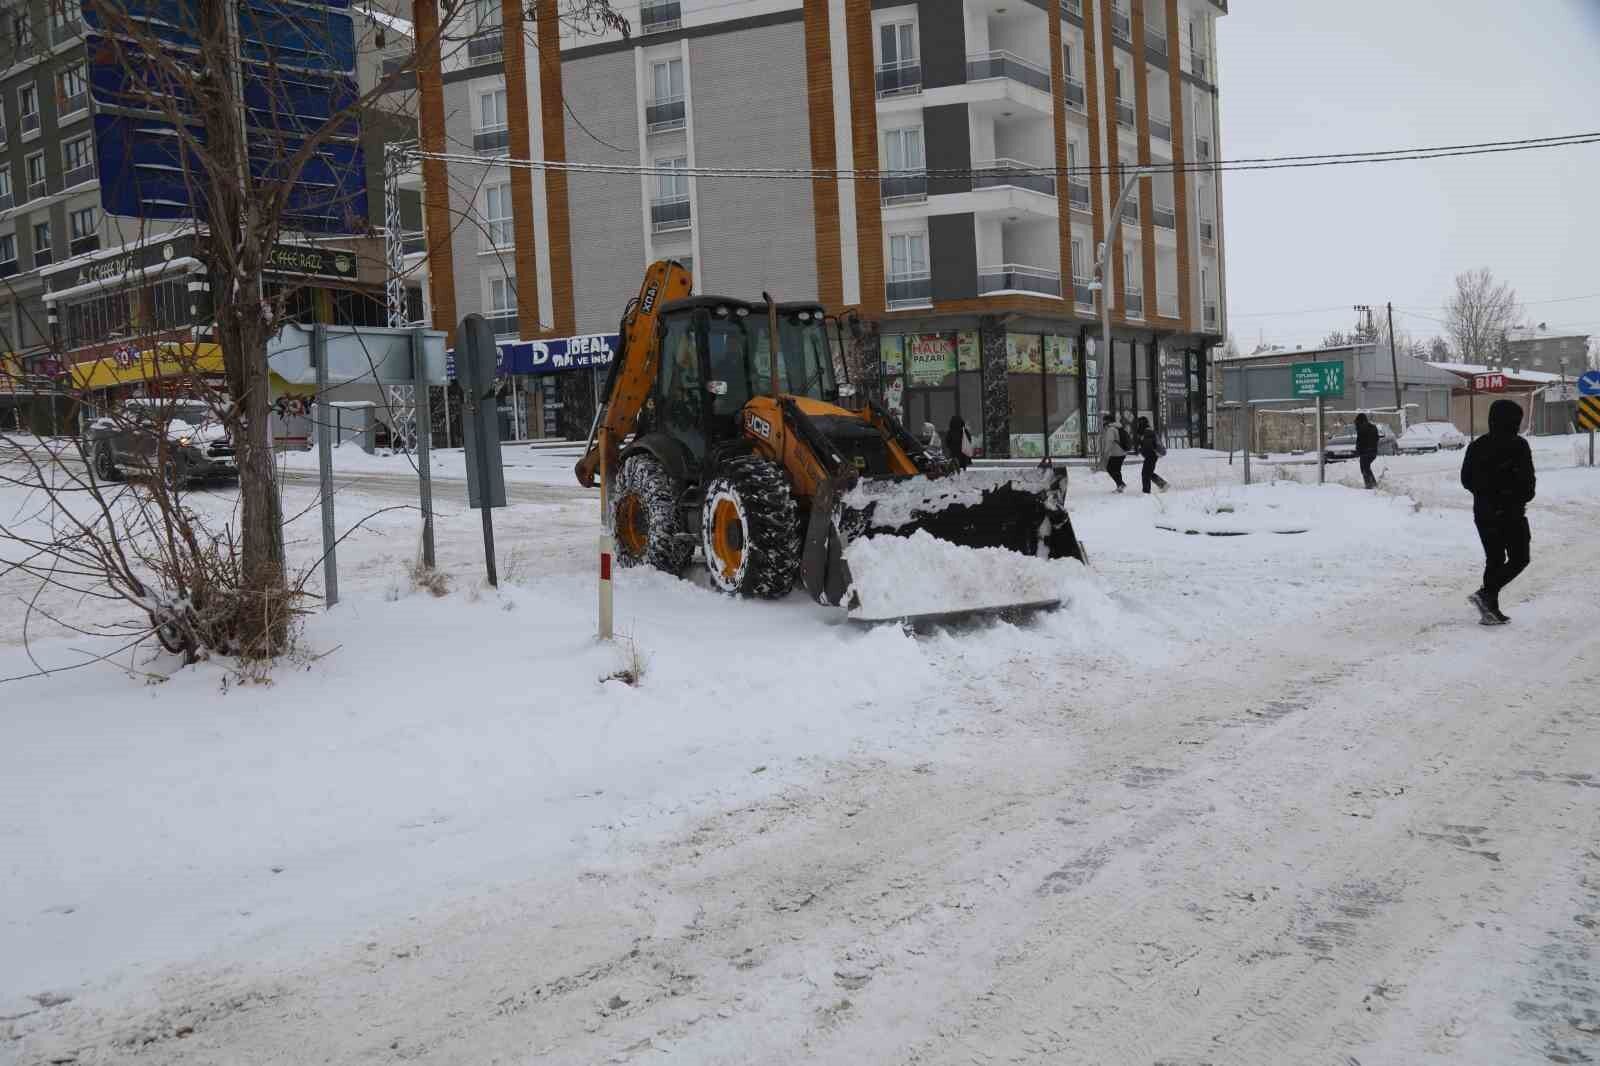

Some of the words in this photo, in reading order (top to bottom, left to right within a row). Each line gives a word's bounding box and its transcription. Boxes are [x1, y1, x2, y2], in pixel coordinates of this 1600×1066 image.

[912, 341, 946, 354] HALK
[577, 356, 589, 365] VE
[751, 414, 770, 438] JCB
